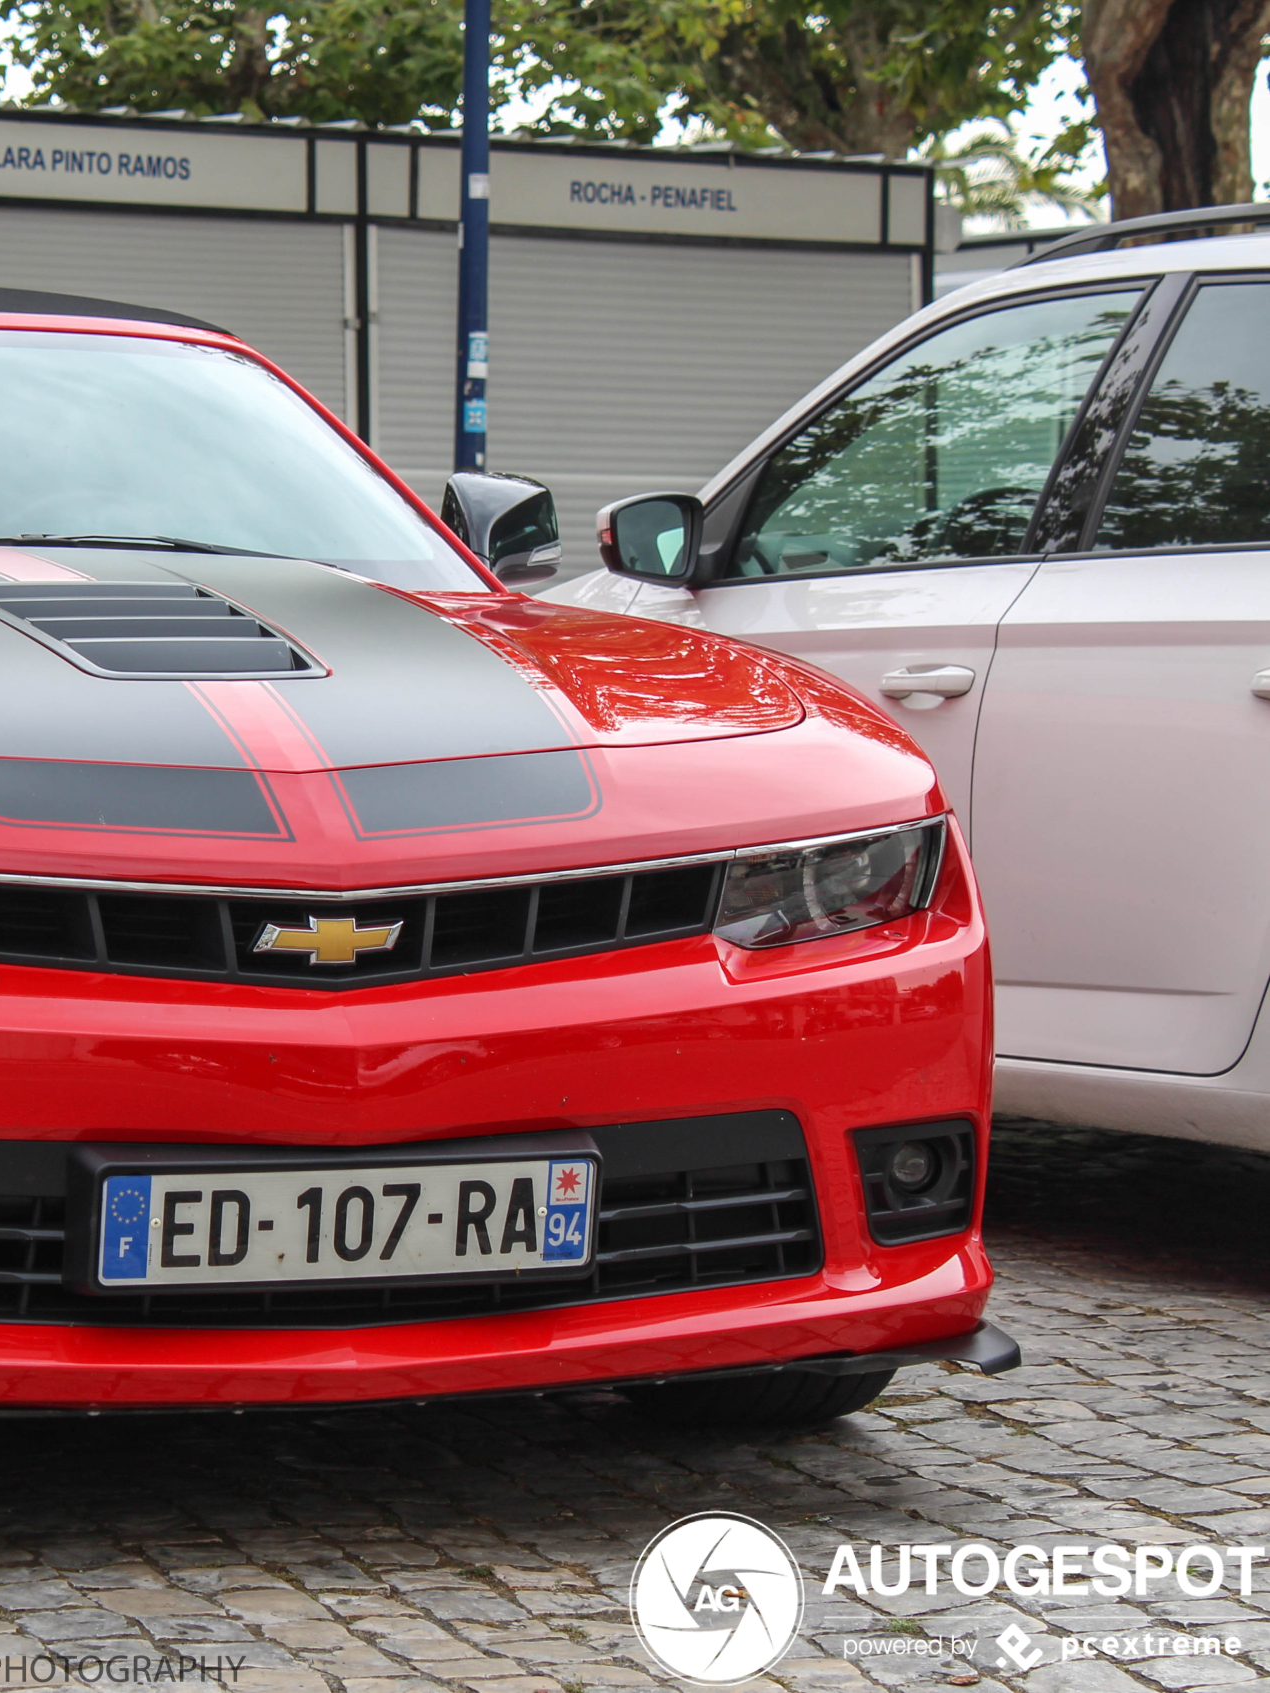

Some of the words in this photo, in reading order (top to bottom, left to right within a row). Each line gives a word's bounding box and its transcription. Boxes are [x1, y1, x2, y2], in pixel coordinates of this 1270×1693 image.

[52, 149, 112, 175] PINTO
[118, 153, 191, 180] RAMOS
[570, 181, 636, 206] ROCHA
[650, 185, 738, 212] PENAFIEL
[548, 1211, 583, 1247] 94
[118, 1236, 133, 1258] F
